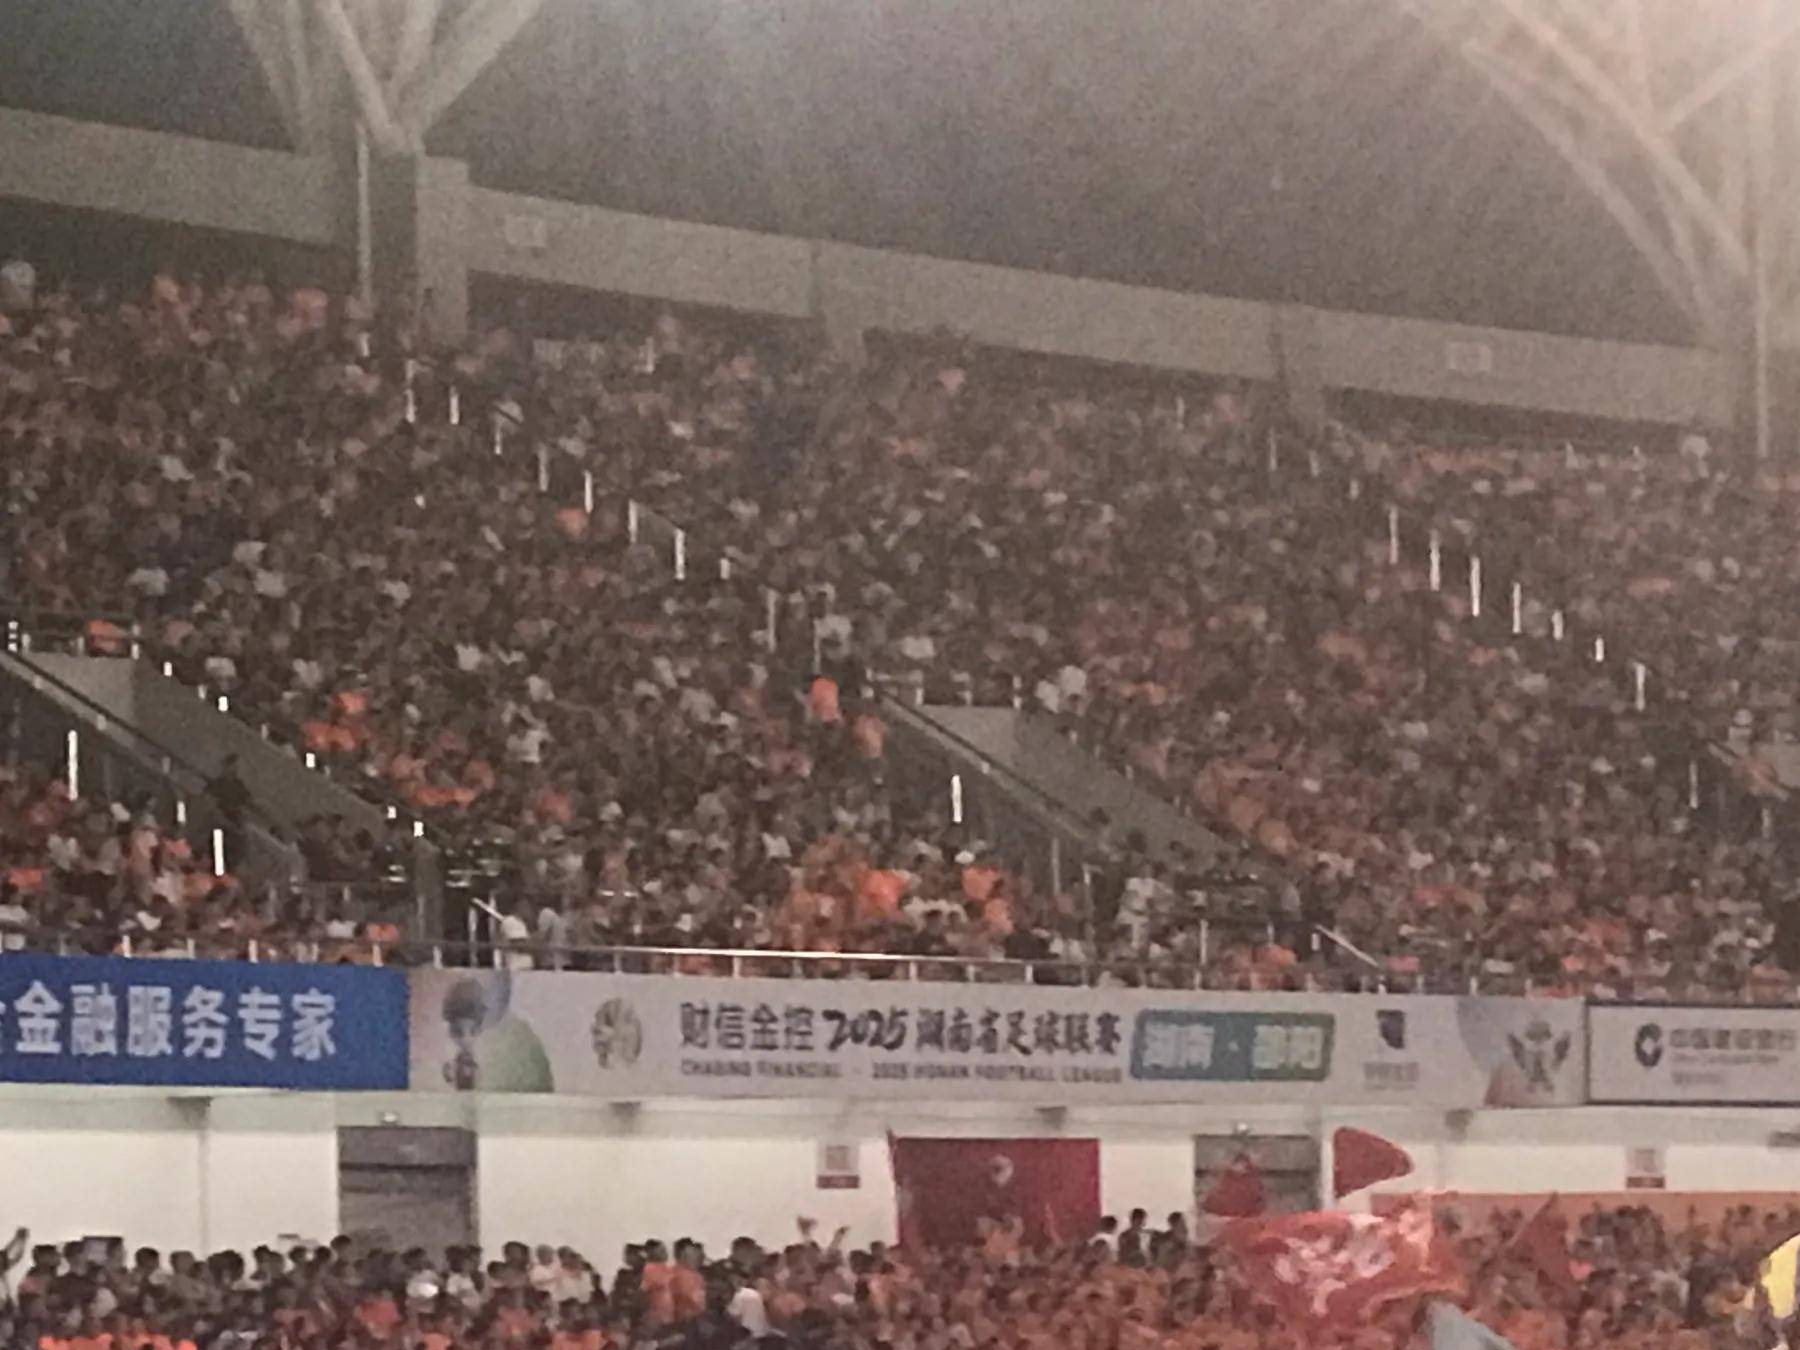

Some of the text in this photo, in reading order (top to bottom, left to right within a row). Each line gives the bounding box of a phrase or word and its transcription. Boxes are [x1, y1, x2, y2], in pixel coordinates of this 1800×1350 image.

[0, 978, 337, 1061] 金融服务专家
